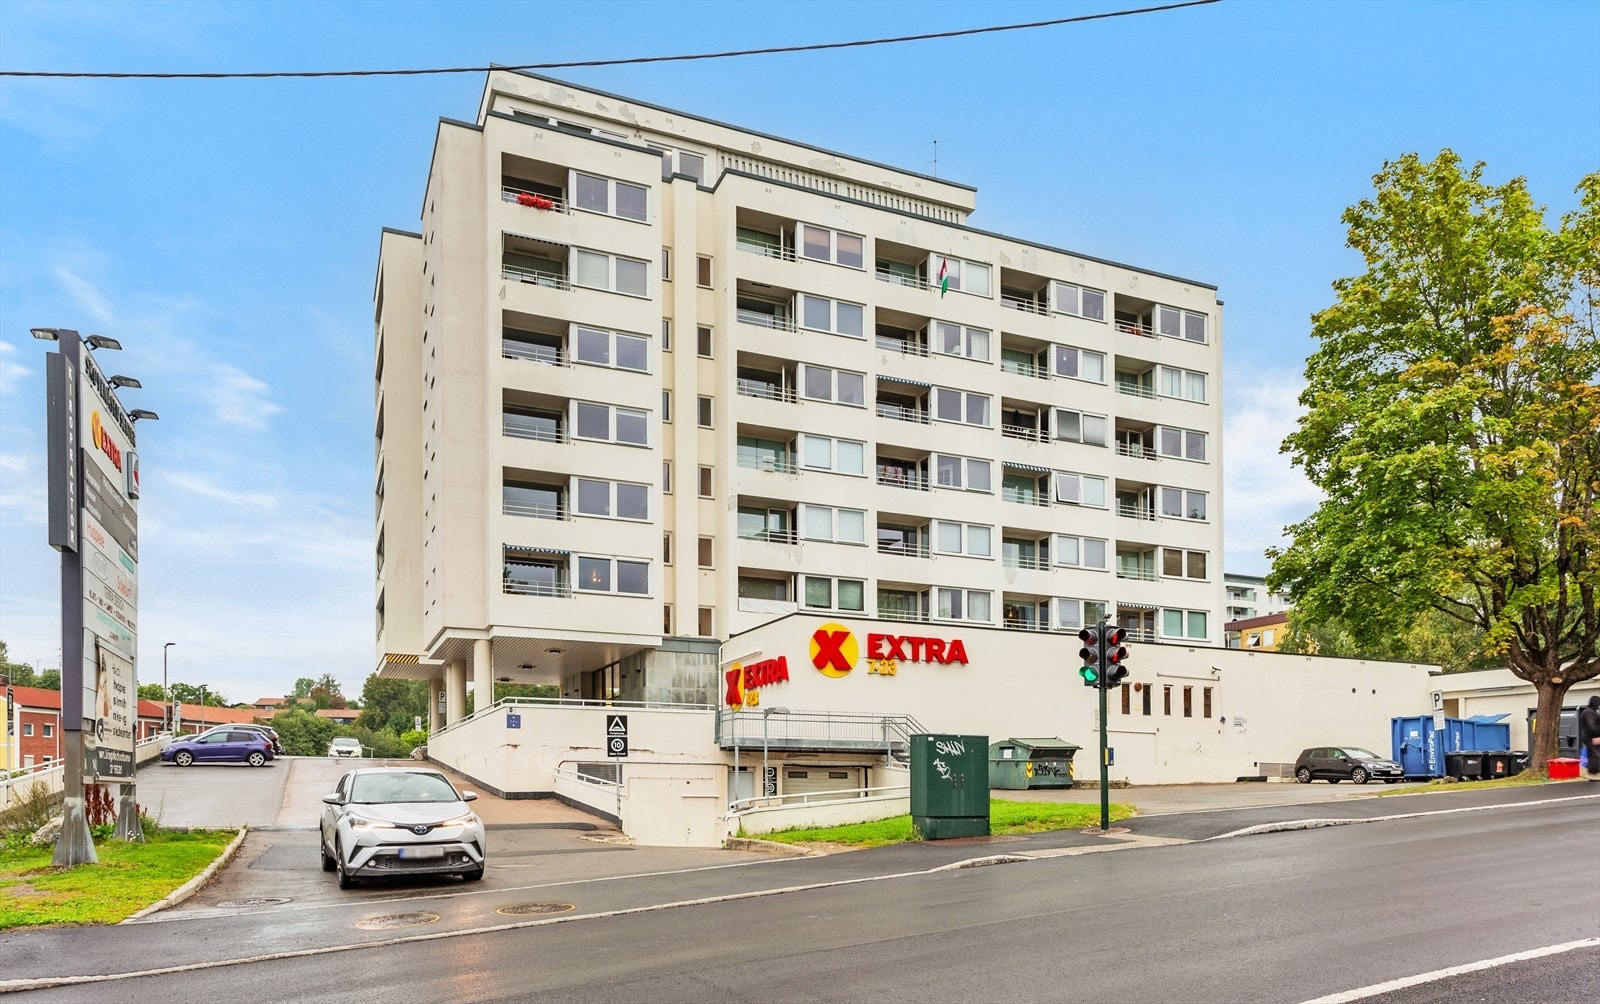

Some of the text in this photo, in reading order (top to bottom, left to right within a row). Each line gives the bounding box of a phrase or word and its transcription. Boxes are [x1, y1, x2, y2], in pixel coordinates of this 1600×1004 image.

[101, 425, 122, 474] EXTRA
[867, 632, 969, 665] EXTRA
[743, 655, 790, 691] EXTRA
[867, 658, 898, 676] 7-23
[1433, 693, 1440, 708] P
[613, 741, 622, 749] 10
